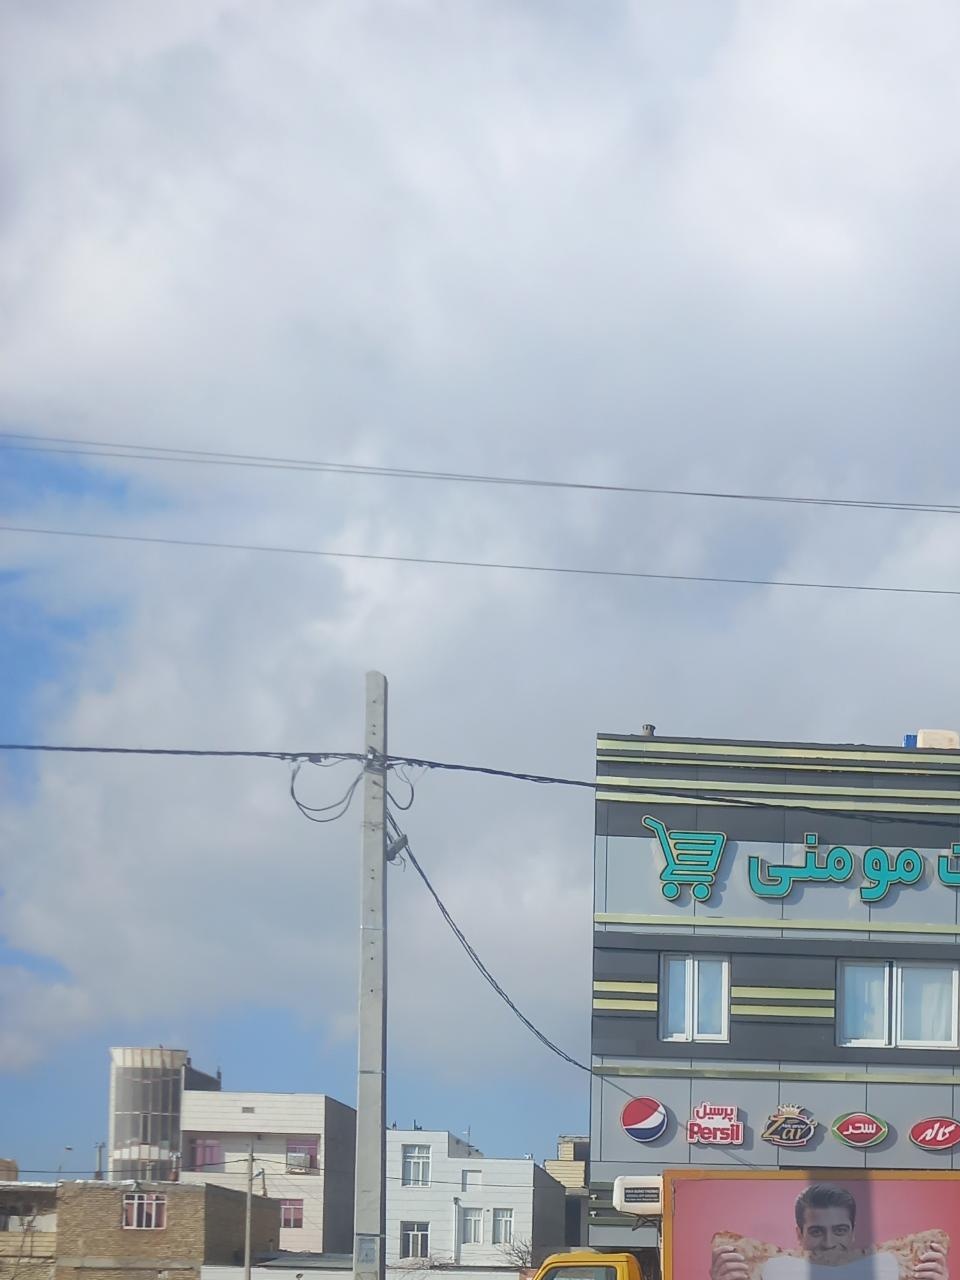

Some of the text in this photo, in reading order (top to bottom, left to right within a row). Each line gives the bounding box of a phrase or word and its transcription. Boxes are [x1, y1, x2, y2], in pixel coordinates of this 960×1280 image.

[748, 832, 924, 902] مومنی
[695, 1103, 736, 1121] پرسیل
[688, 1121, 741, 1142] Persil
[762, 1114, 810, 1141] Zar
[842, 1121, 877, 1135] سحر
[918, 1122, 957, 1142] کاله
